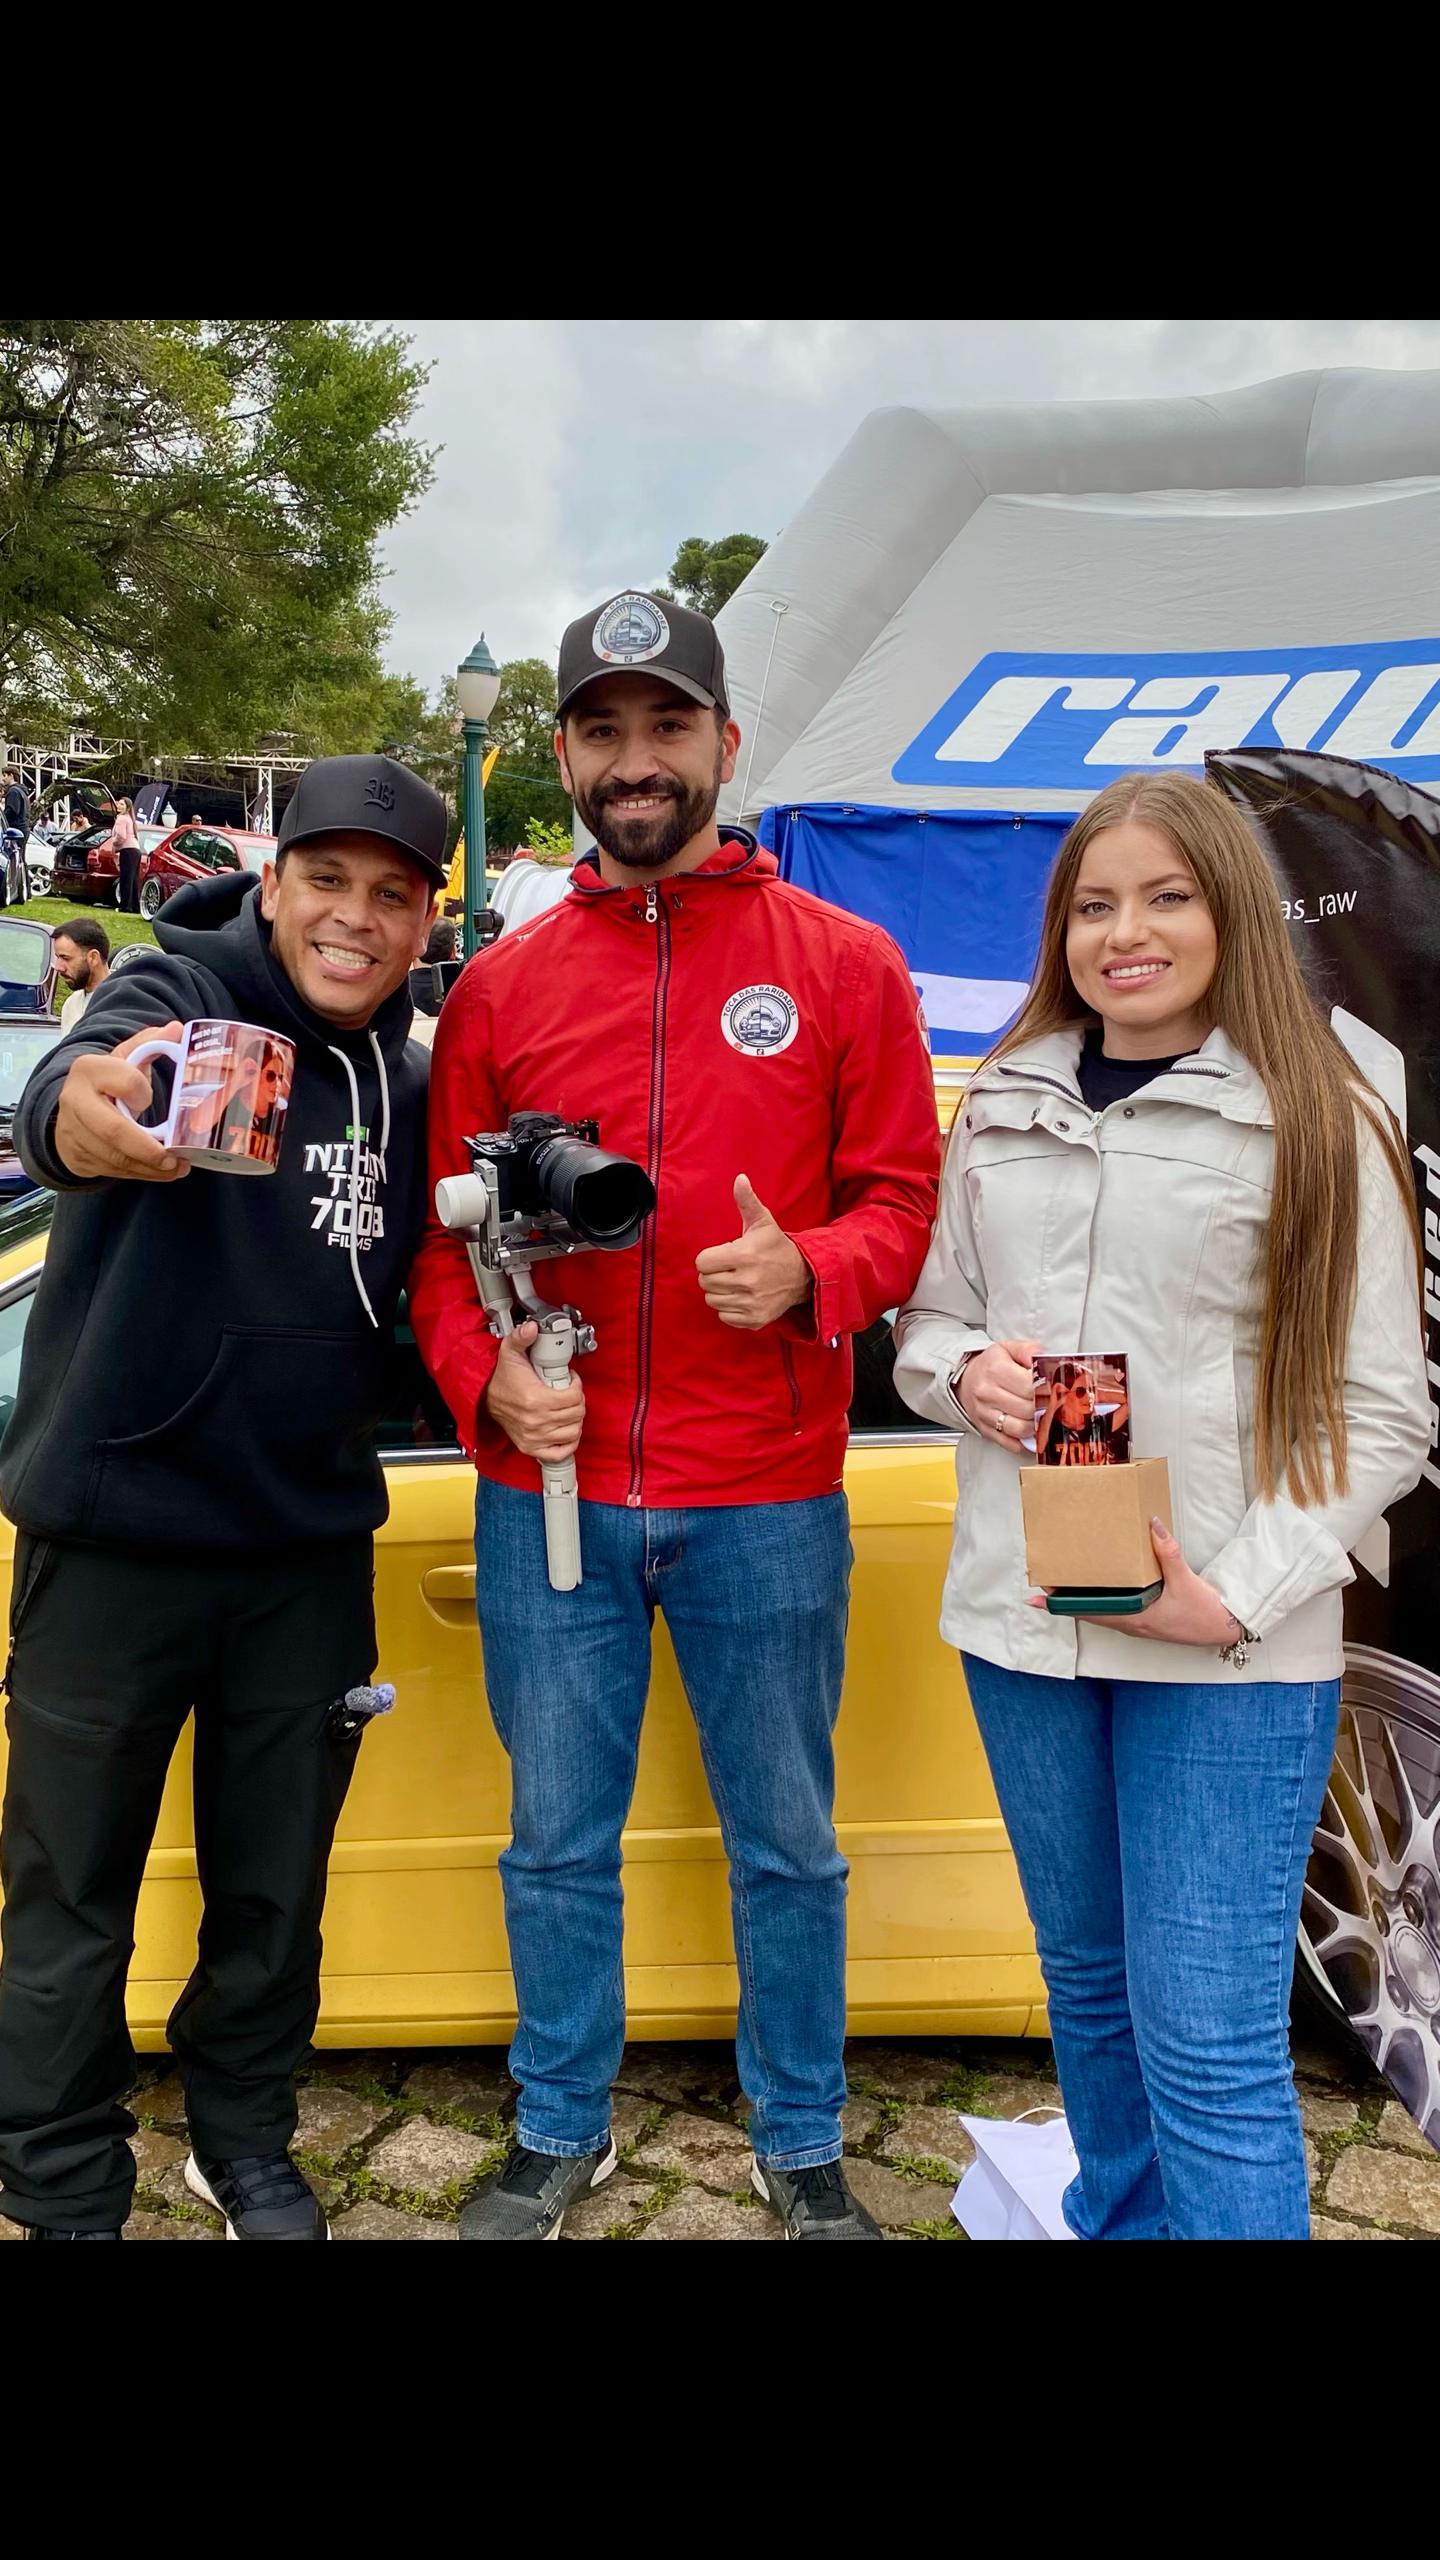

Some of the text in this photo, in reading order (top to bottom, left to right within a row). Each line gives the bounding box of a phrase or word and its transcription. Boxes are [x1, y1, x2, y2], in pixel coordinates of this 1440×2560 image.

[609, 597, 626, 609] DAS
[629, 596, 668, 630] RARIDADES
[723, 986, 797, 1017] TOCA DAS RARIDADES
[327, 1232, 373, 1251] FILMS
